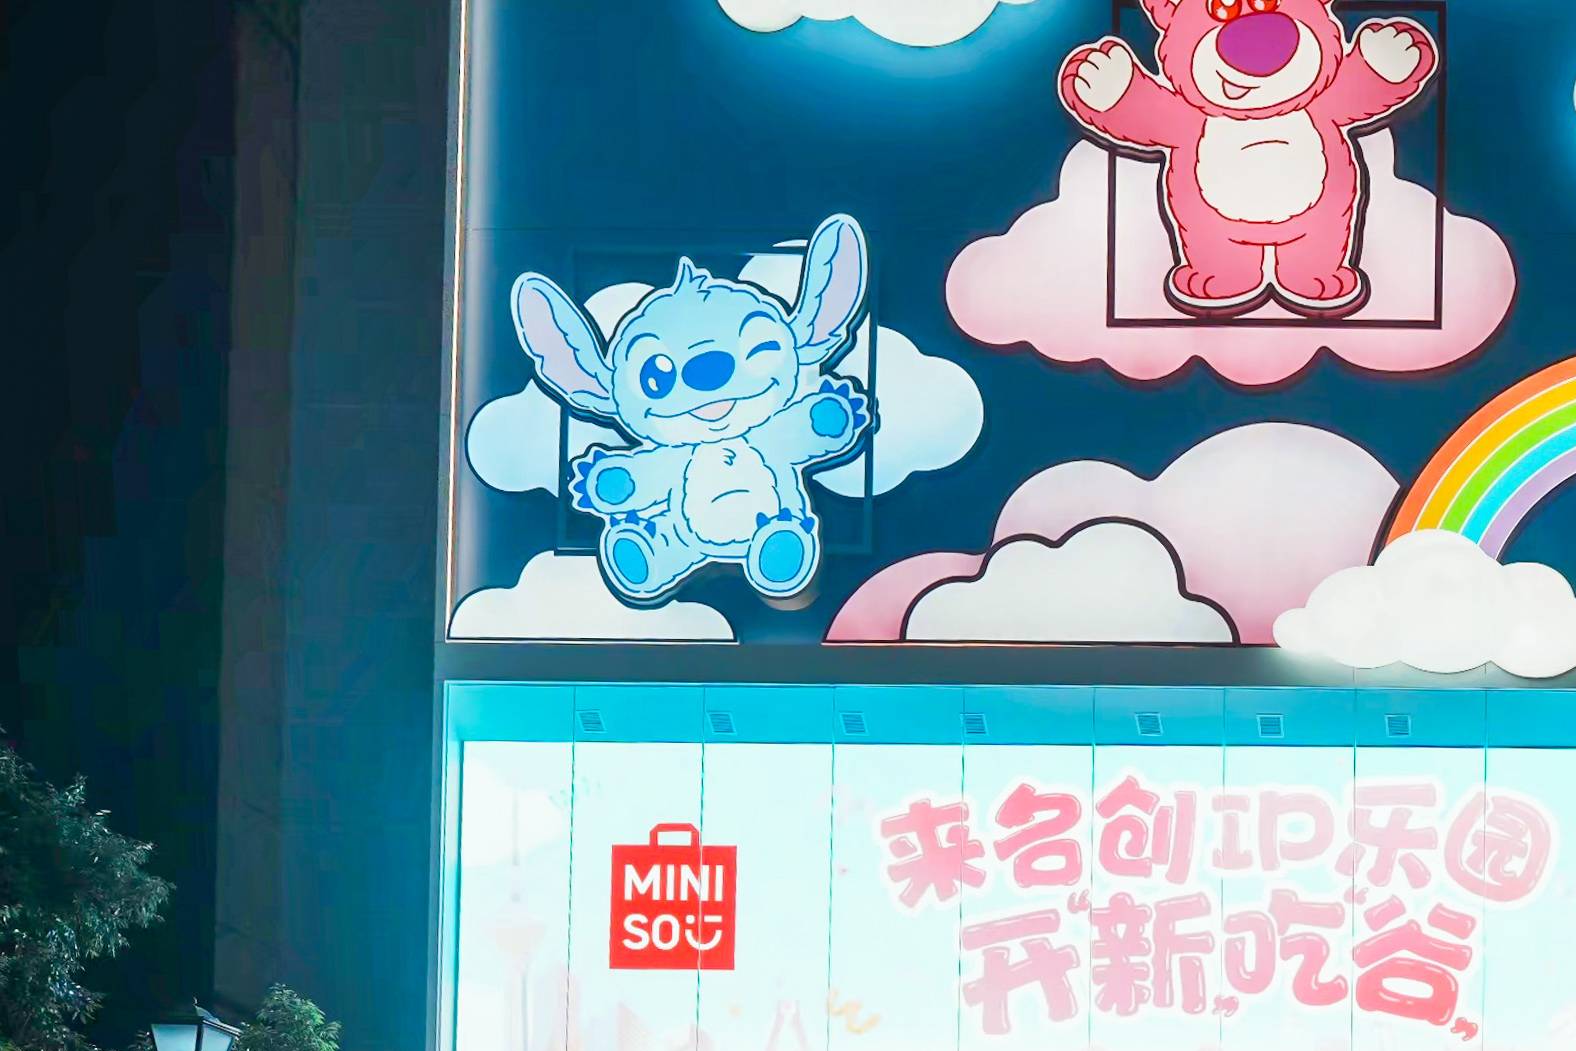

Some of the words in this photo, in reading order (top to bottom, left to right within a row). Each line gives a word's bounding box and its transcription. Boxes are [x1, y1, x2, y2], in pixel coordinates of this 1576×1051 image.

[622, 865, 724, 901] MINI
[881, 776, 1552, 908] 来名创IP乐园
